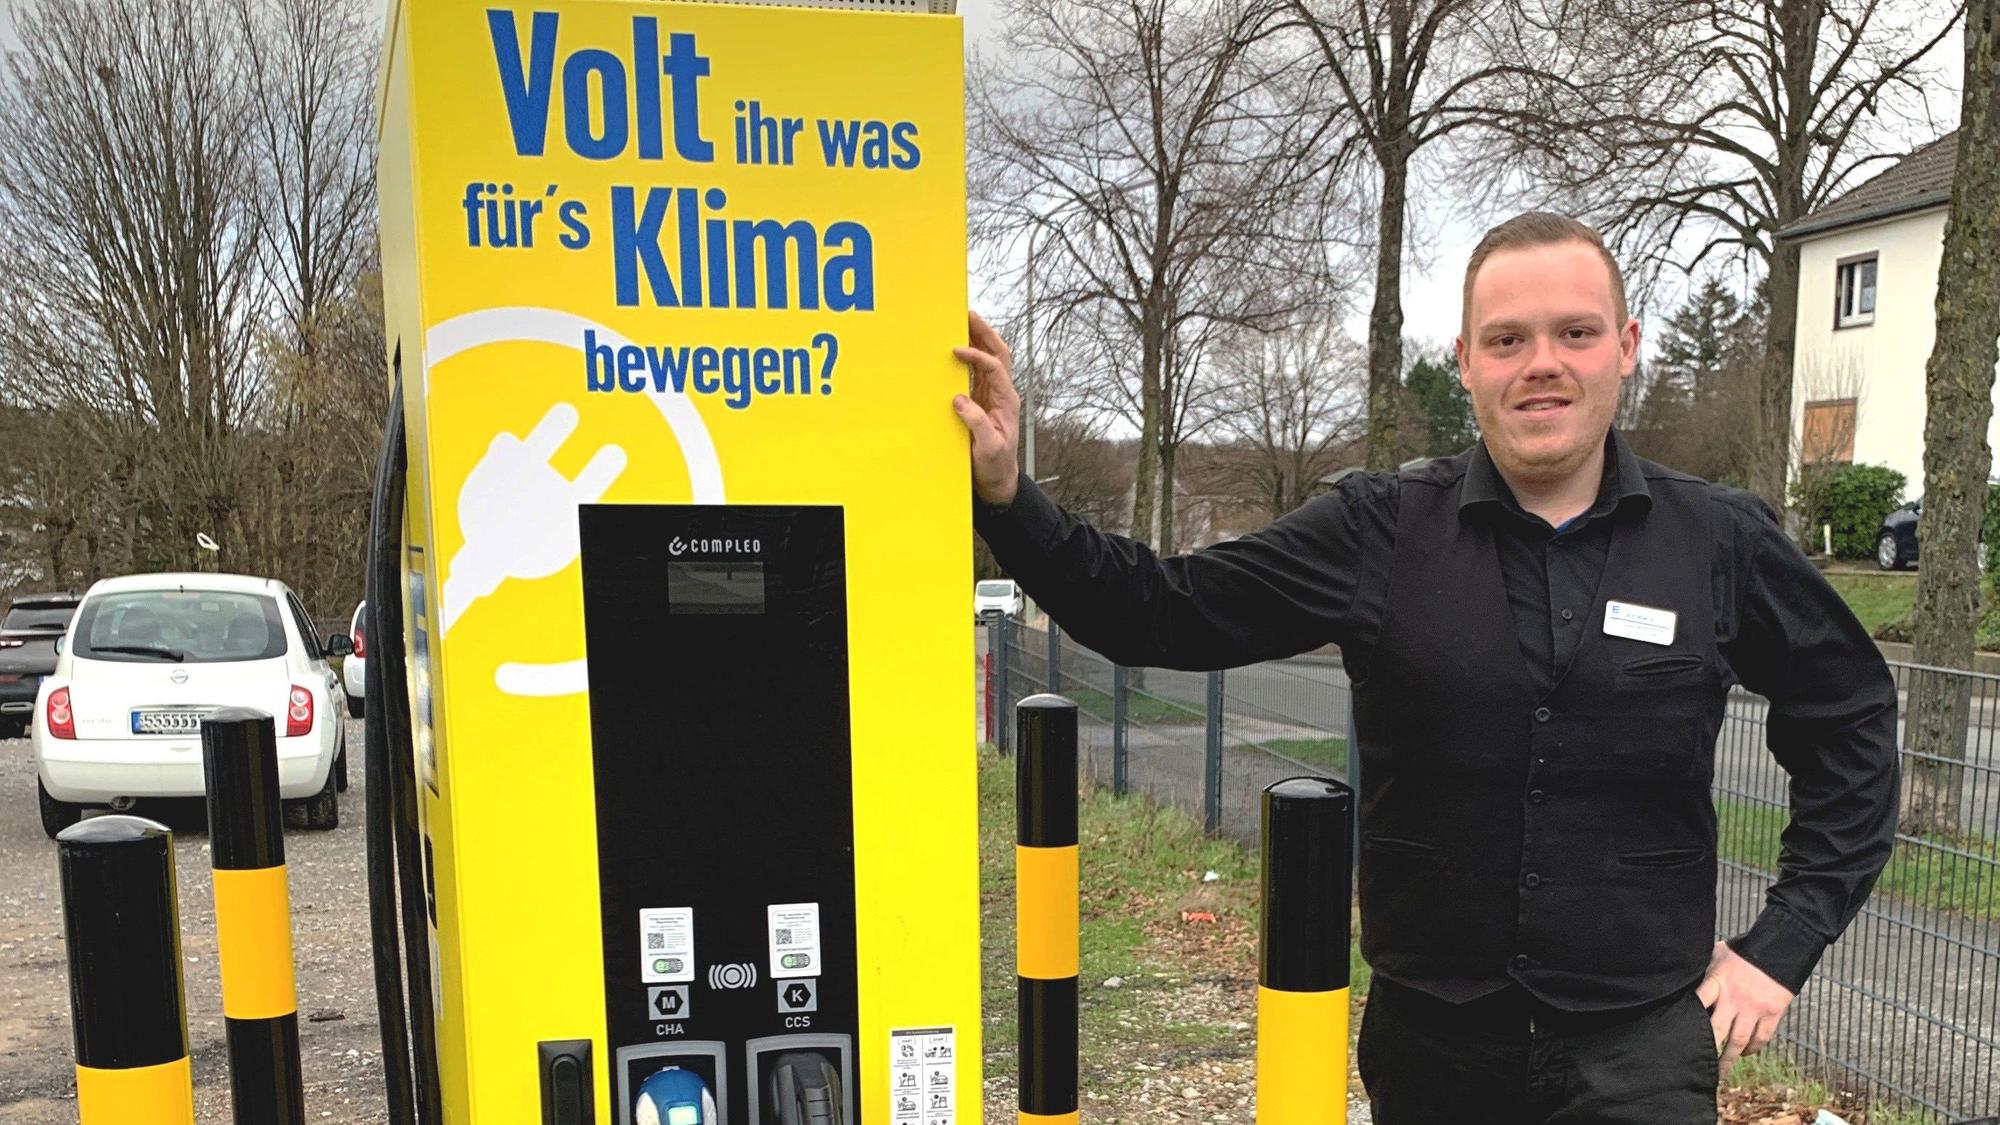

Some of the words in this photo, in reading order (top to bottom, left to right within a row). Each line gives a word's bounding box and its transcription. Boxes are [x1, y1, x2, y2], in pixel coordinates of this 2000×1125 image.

[487, 9, 714, 162] Volt
[735, 100, 803, 165] ihr
[818, 119, 921, 170] was
[611, 186, 875, 312] Klima
[584, 329, 839, 409] bewegen?
[690, 538, 761, 553] COMPLEO
[661, 995, 676, 1010] M
[791, 989, 804, 1003] K
[655, 1023, 685, 1036] CHA
[784, 1015, 811, 1029] CCS
